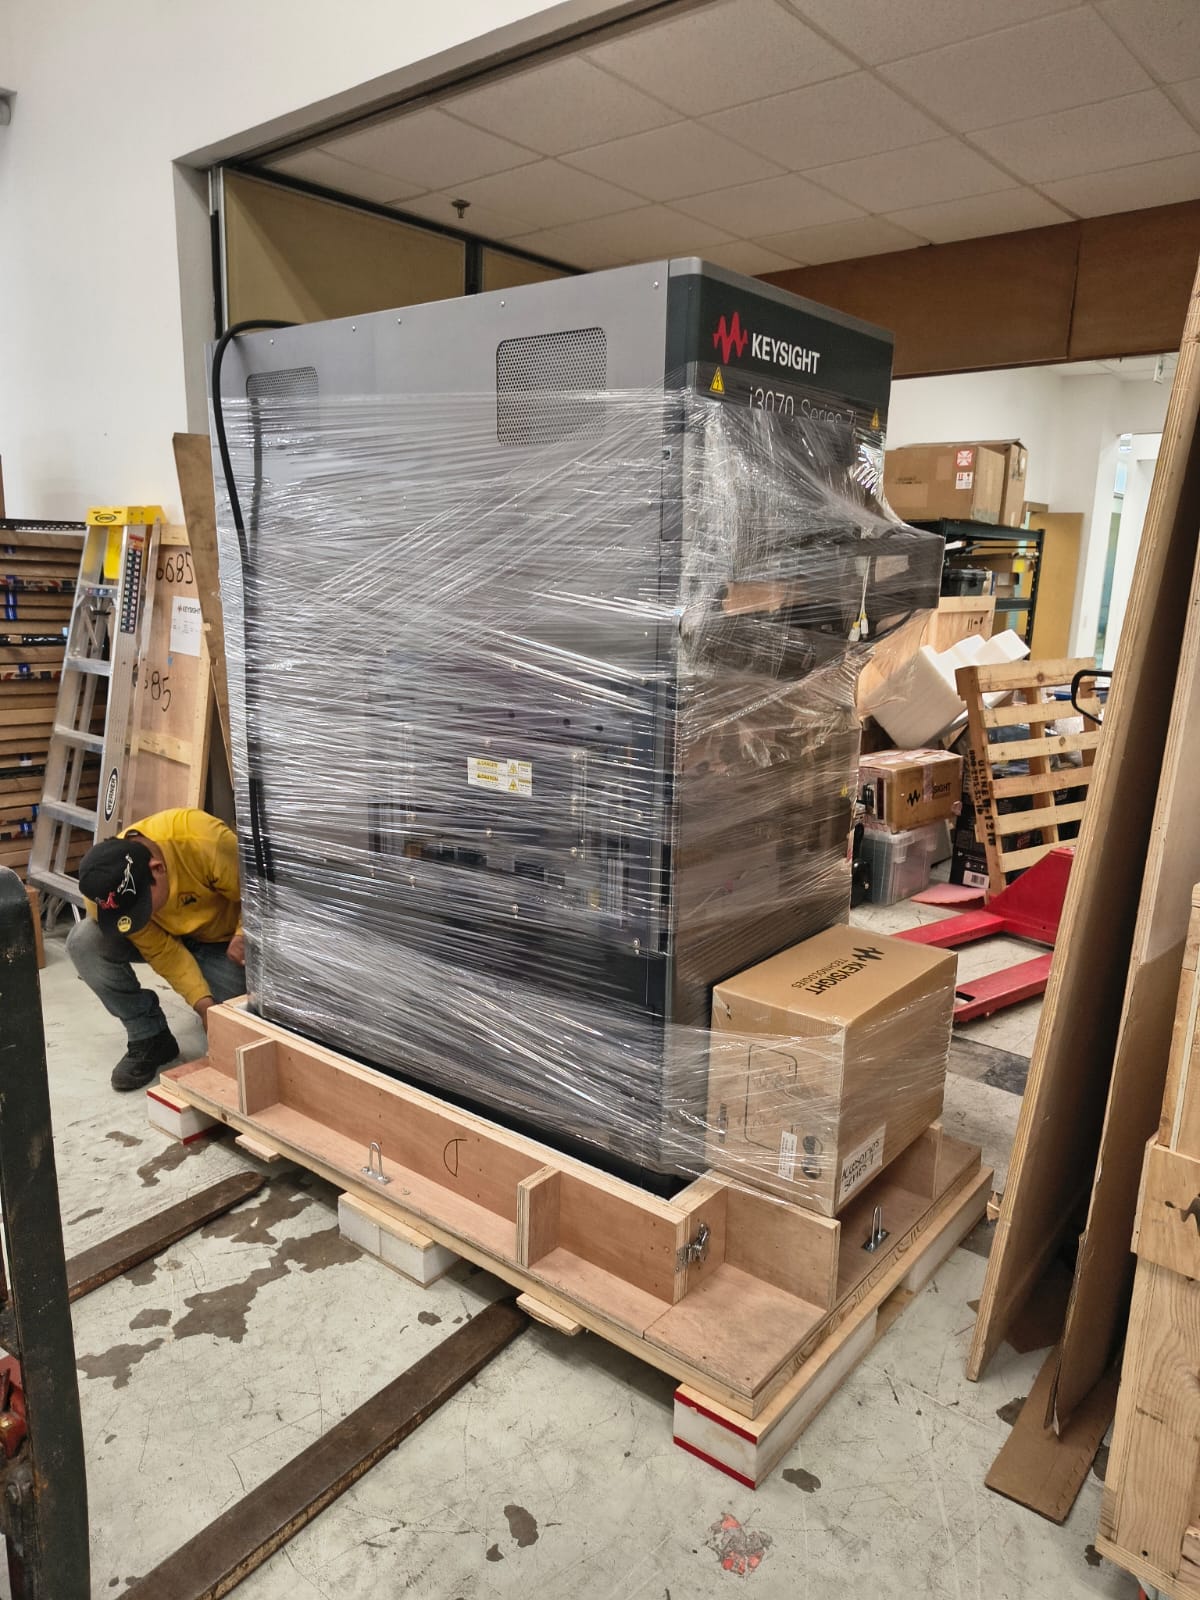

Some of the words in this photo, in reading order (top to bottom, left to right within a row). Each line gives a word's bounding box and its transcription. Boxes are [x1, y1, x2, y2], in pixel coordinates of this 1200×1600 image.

[751, 332, 821, 374] KEYSIGHT
[749, 386, 794, 417] i3070
[791, 958, 849, 989] TECHNOLOGIES
[805, 961, 867, 995] KEYSIGHT
